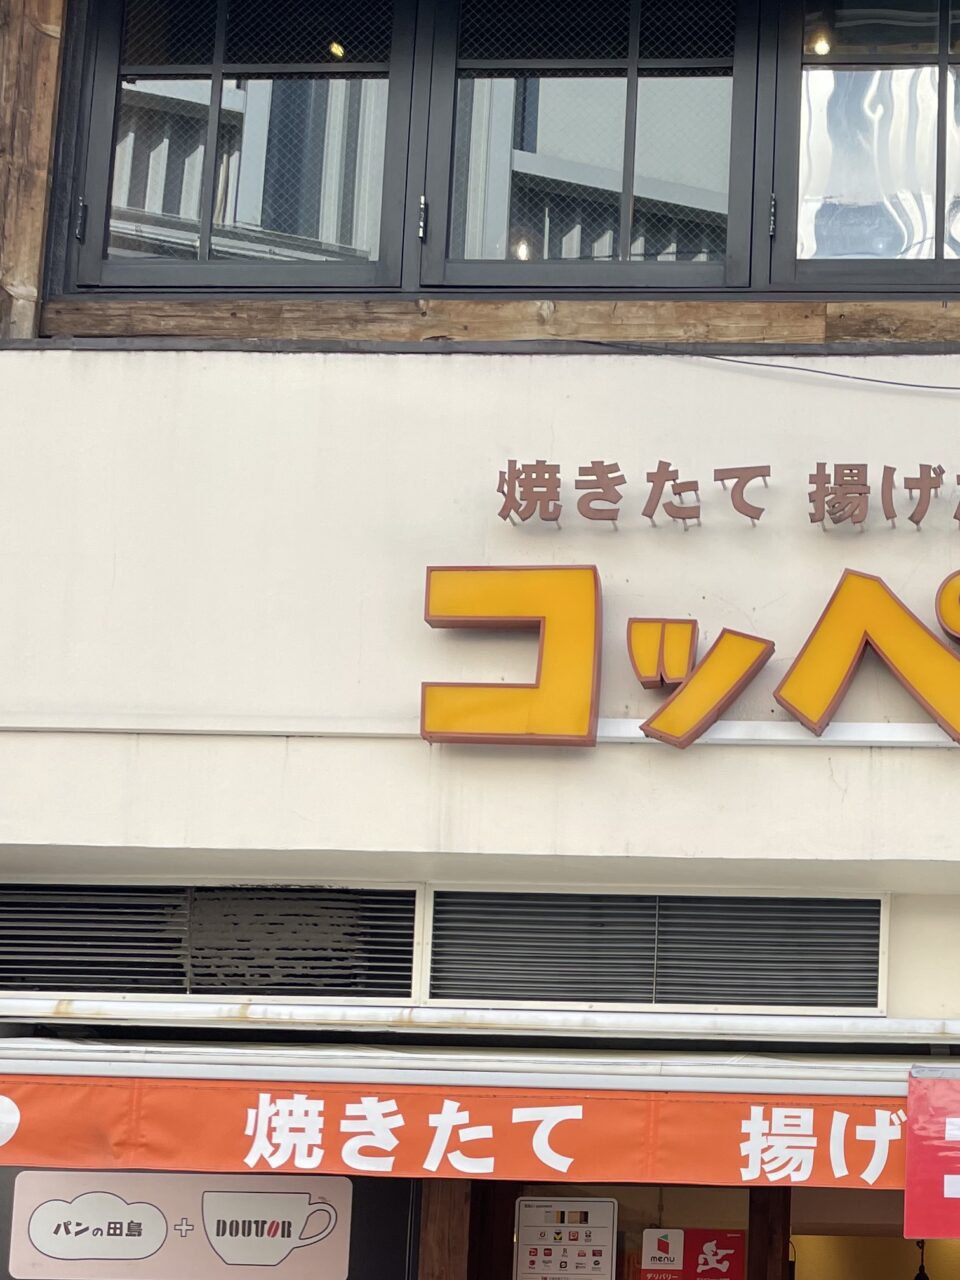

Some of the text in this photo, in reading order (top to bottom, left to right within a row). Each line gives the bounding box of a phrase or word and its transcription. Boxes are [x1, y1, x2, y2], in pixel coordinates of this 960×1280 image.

[496, 459, 771, 524] 焼きたて
[243, 1092, 584, 1174] 焼きたて
[53, 1220, 143, 1238] パンの田島
[215, 1218, 292, 1239] DOUTOR
[650, 1255, 675, 1263] menu
